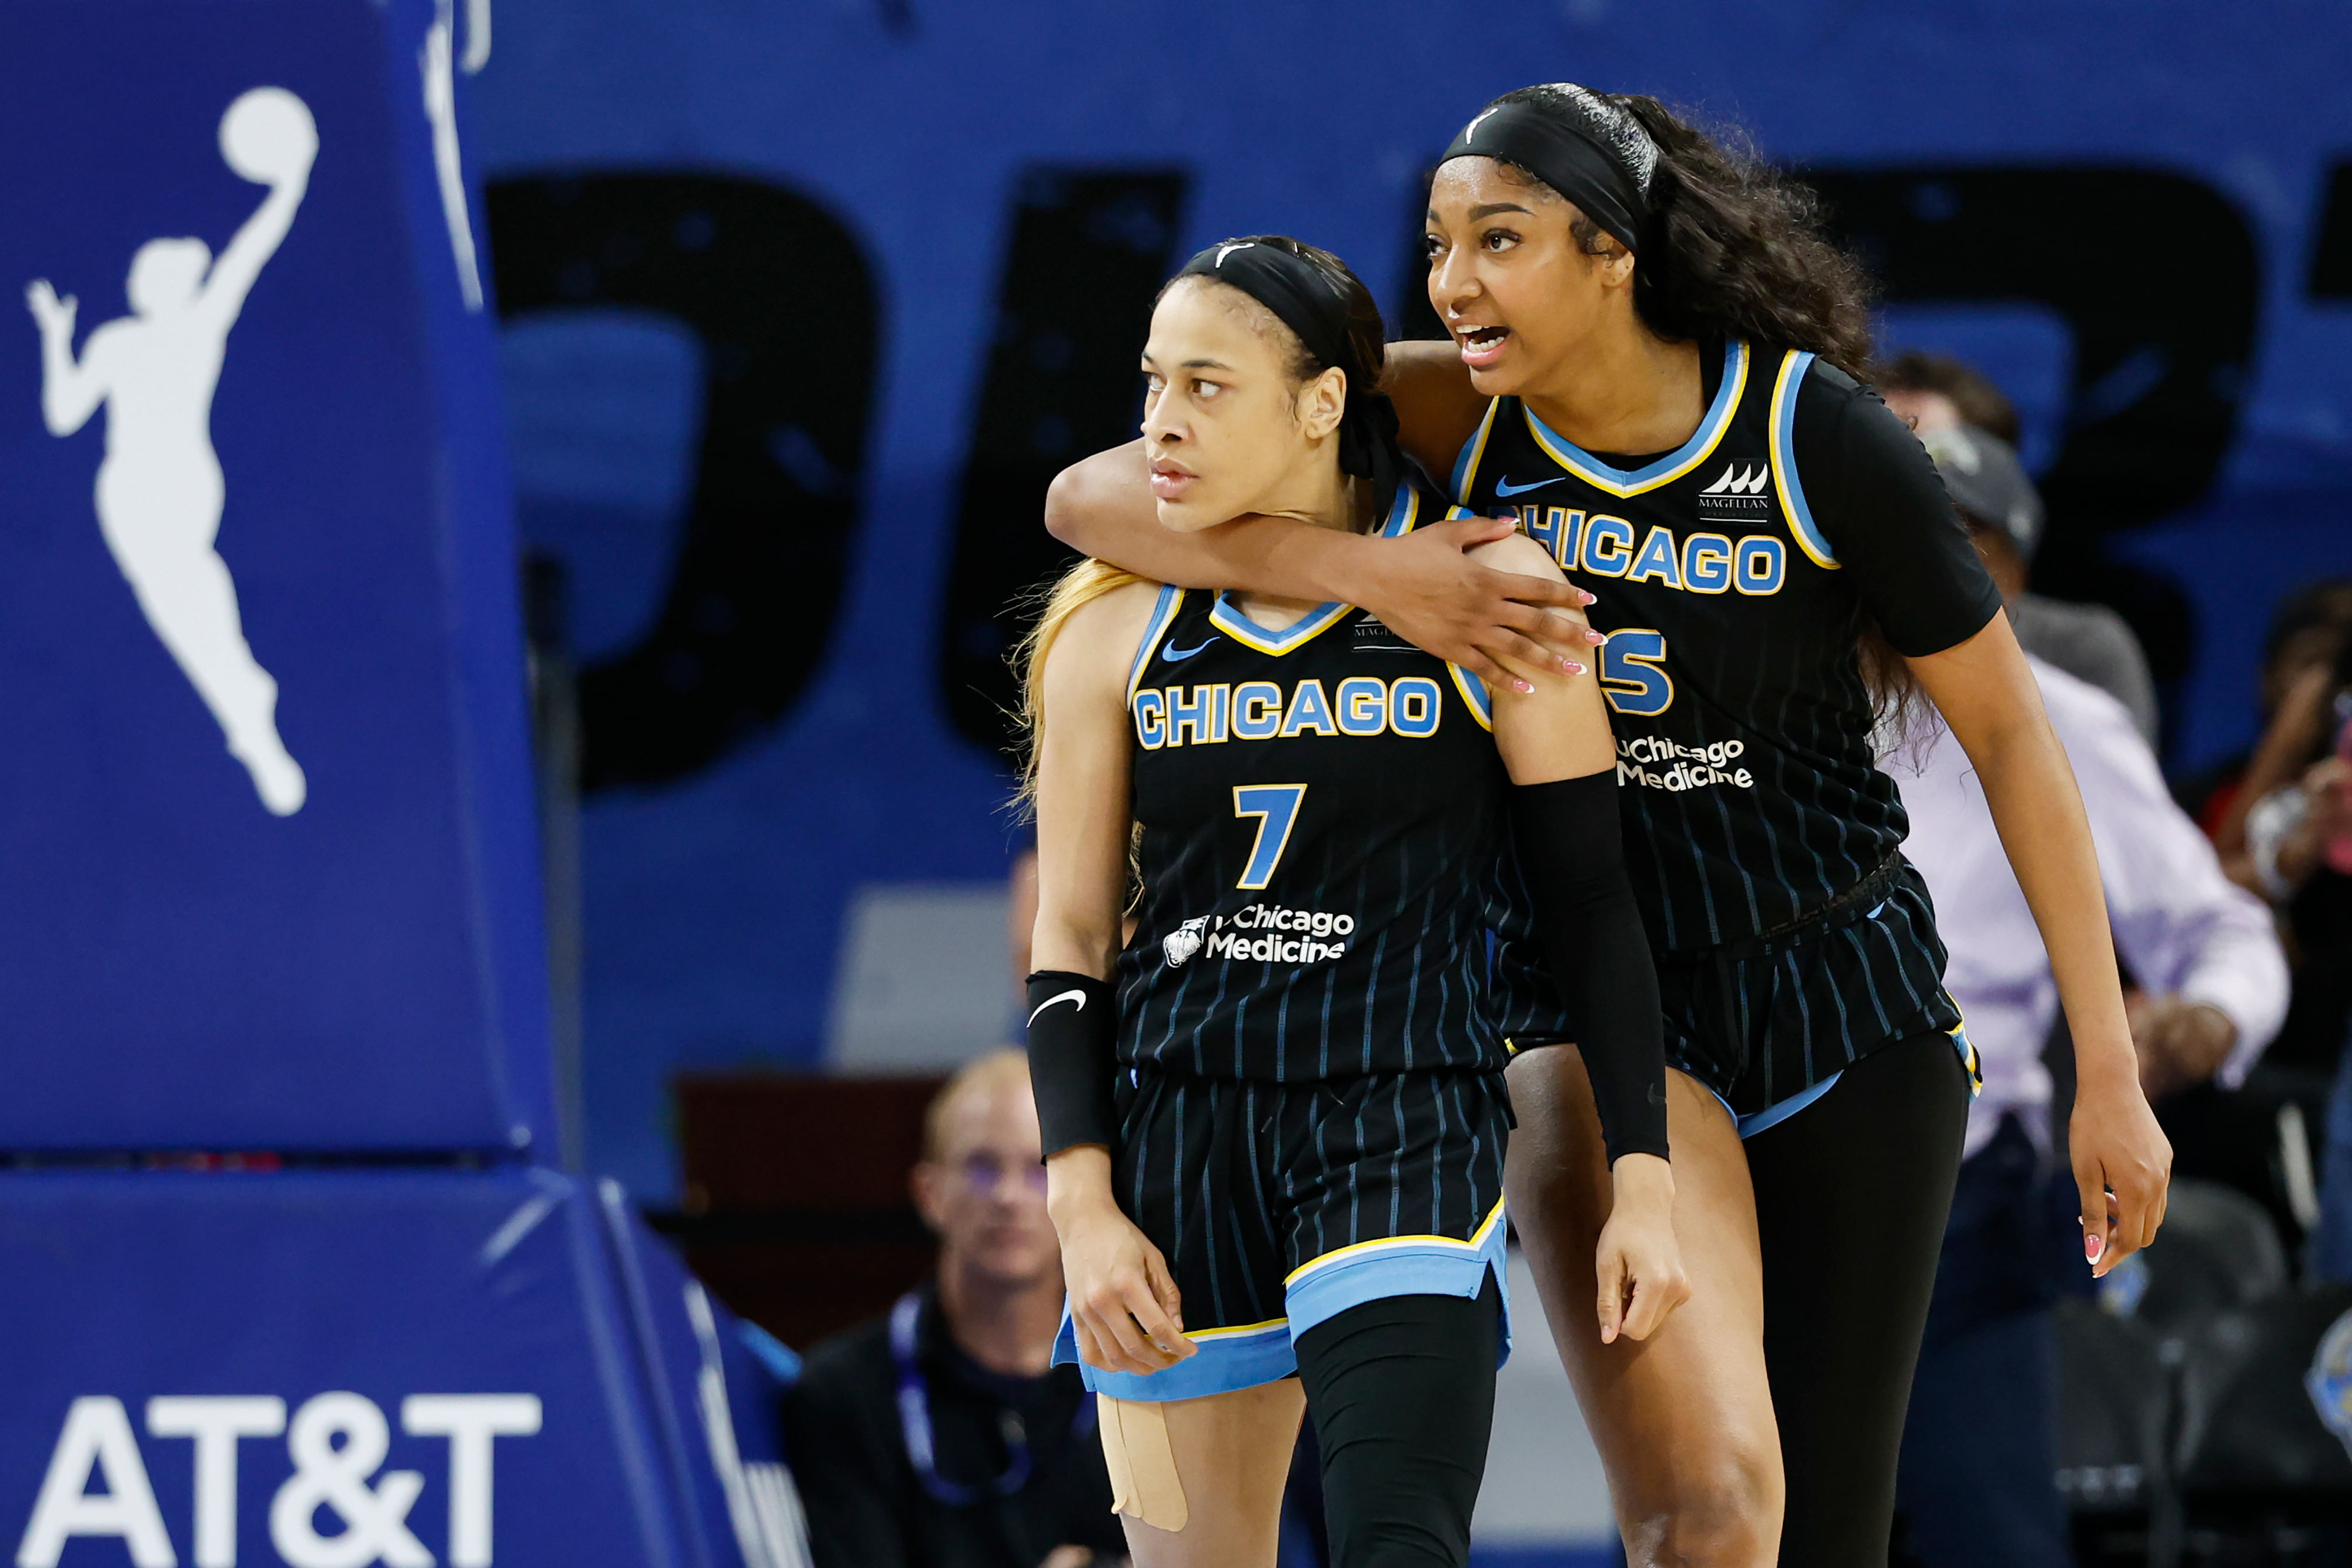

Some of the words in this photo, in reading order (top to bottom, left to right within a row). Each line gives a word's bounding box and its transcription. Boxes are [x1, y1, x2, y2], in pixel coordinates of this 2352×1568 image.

[1699, 498, 1768, 509] MAGELLAN
[1487, 504, 1786, 596] HICAGO
[1599, 628, 1674, 716] 5
[1134, 677, 1442, 750] CHICAGO
[1616, 761, 1754, 792] Medicine
[1233, 783, 1308, 890] 7
[1205, 932, 1345, 964] Medicine
[15, 1390, 543, 1568] AT&T
